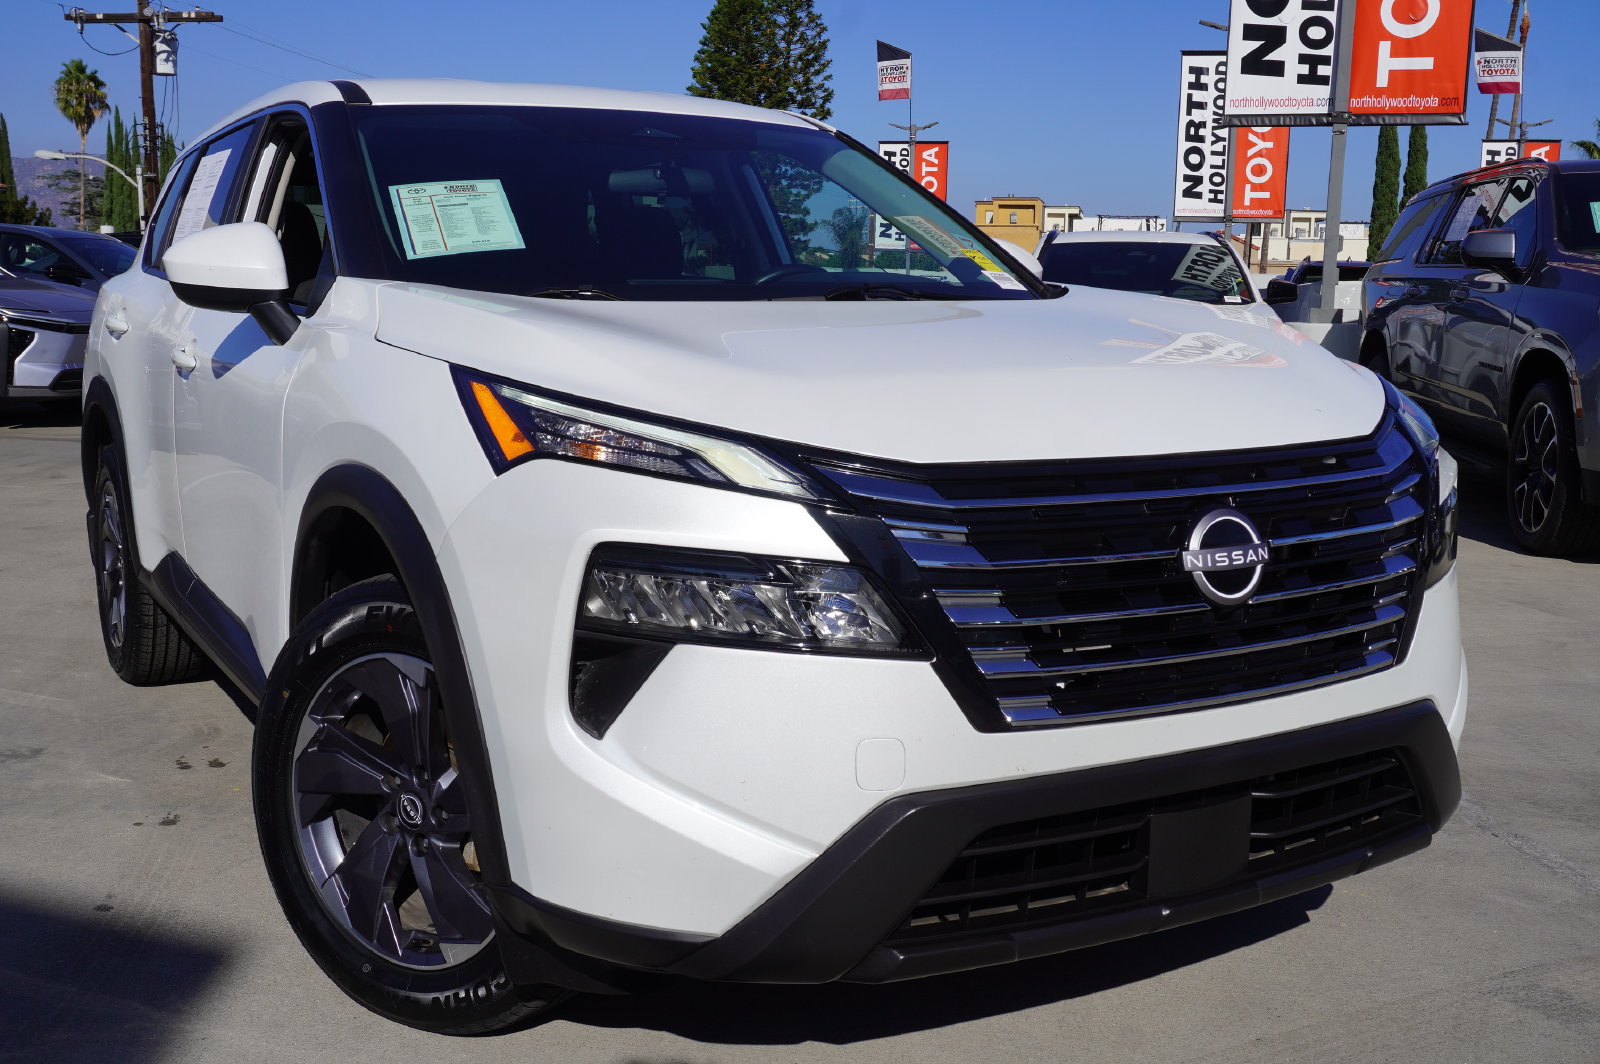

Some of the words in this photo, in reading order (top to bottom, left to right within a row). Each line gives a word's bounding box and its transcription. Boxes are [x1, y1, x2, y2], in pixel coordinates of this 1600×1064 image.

[1350, 94, 1459, 110] northhollywoodtoyota.com
[1182, 65, 1209, 199] NORTH
[1244, 127, 1274, 206] TOY
[1186, 546, 1269, 568] NISSAN
